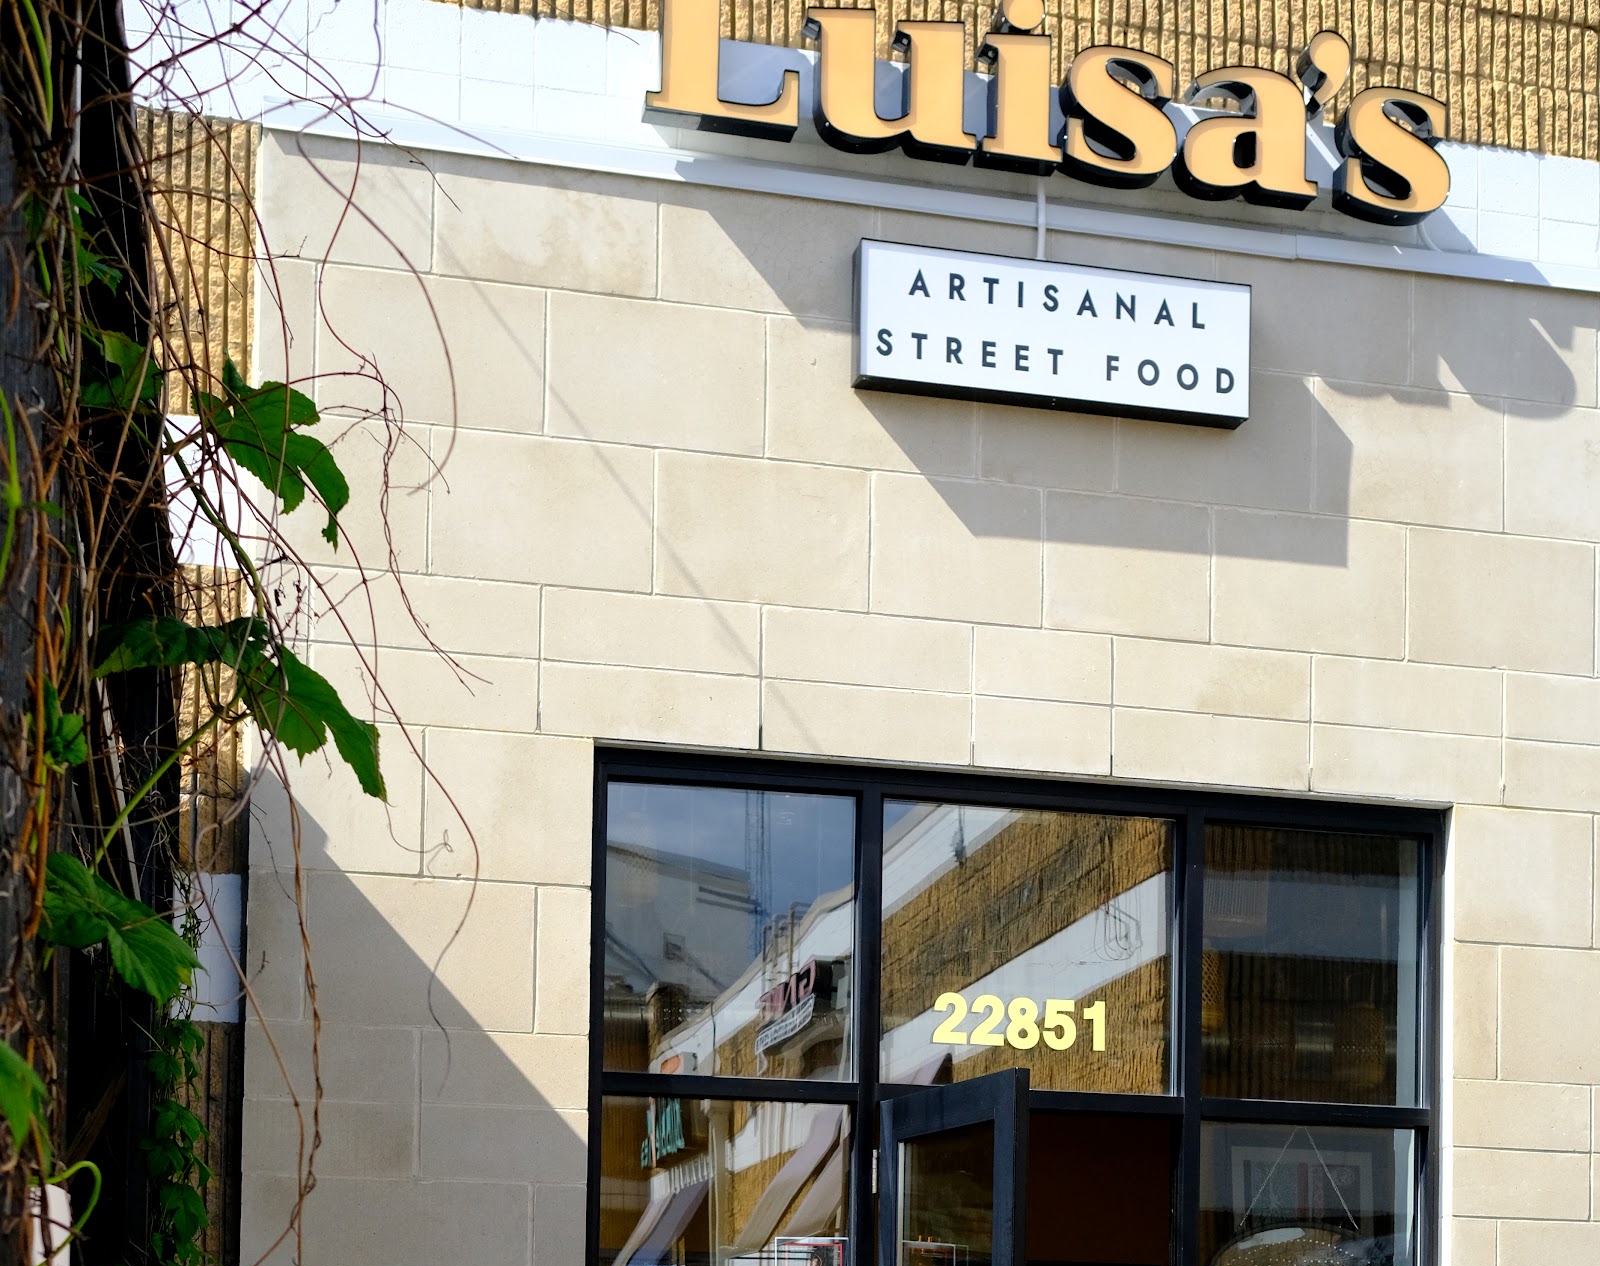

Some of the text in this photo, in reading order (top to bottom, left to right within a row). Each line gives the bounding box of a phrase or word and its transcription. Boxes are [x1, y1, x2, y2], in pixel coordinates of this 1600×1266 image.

[645, 0, 1452, 224] Luisa's
[908, 268, 1206, 331] ARTISANAL
[875, 328, 1236, 395] STREET FOOD
[932, 991, 1106, 1052] 22851
